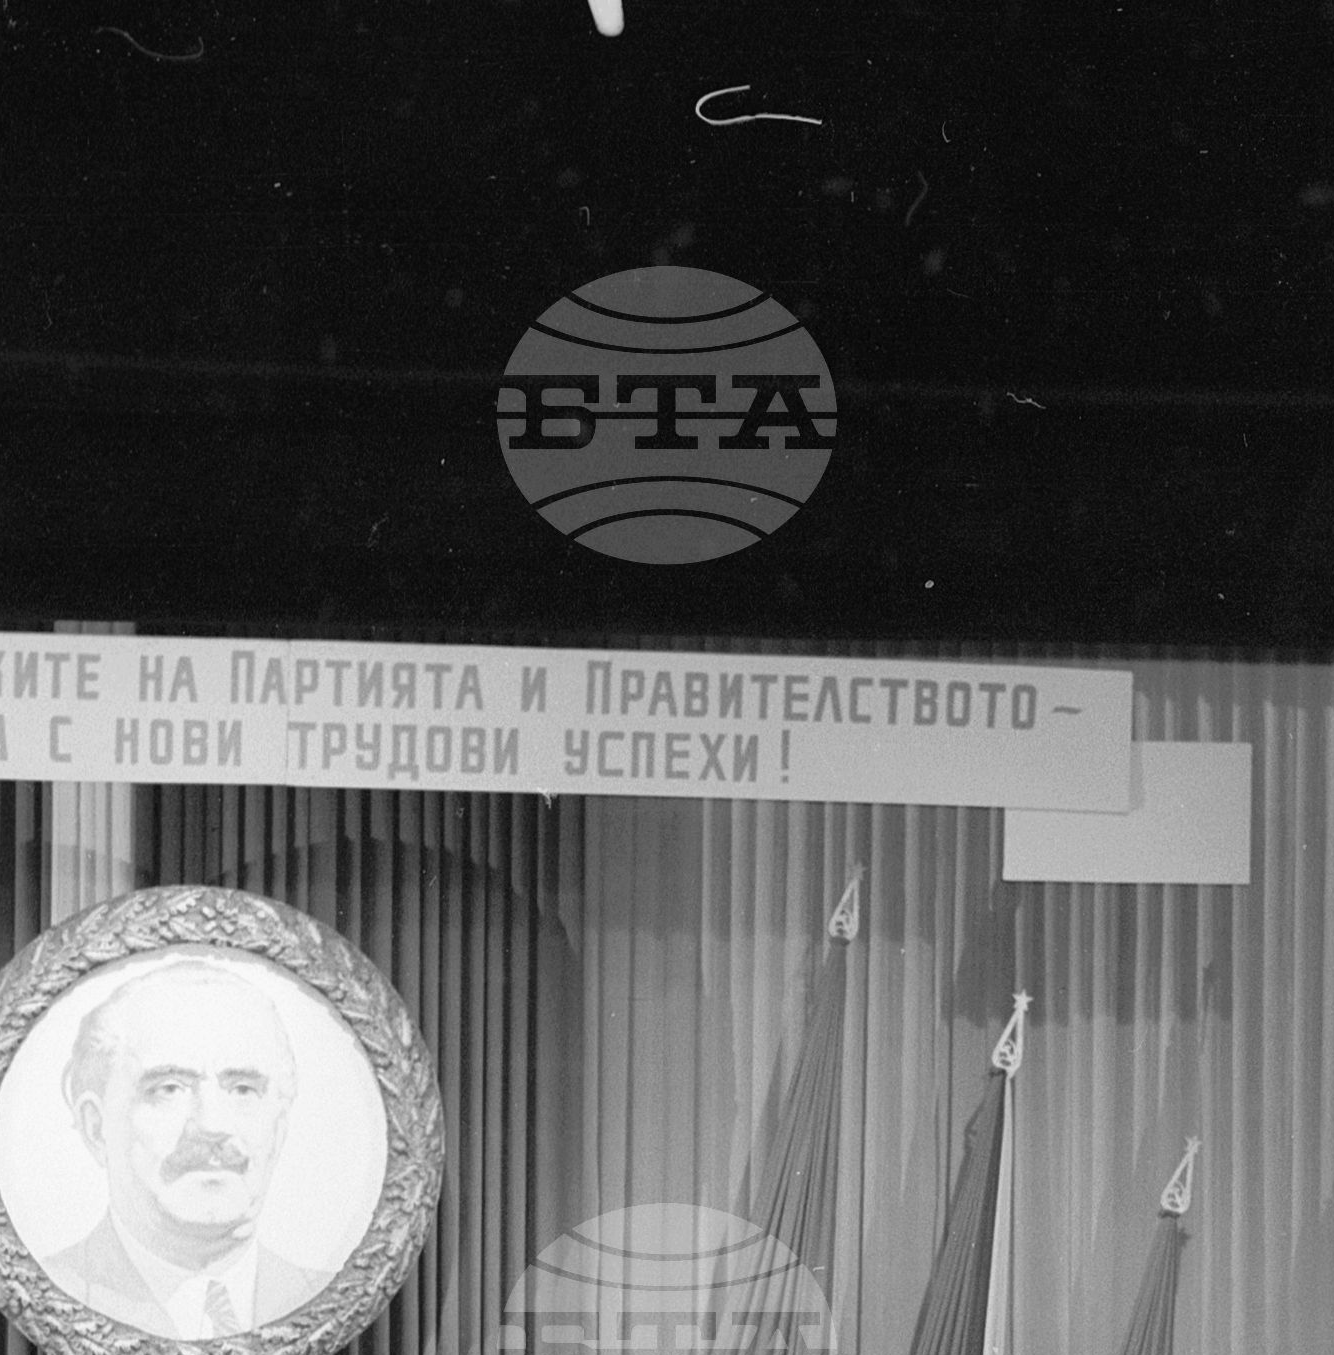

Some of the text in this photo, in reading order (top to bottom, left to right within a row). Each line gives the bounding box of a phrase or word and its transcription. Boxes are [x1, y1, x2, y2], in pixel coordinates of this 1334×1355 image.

[138, 654, 198, 703] НА
[231, 650, 484, 711] ПАРТИЯТА
[521, 666, 548, 713] И
[48, 715, 73, 763] С
[115, 717, 243, 767] НОВИ
[286, 721, 520, 782] ТРУДОВИ
